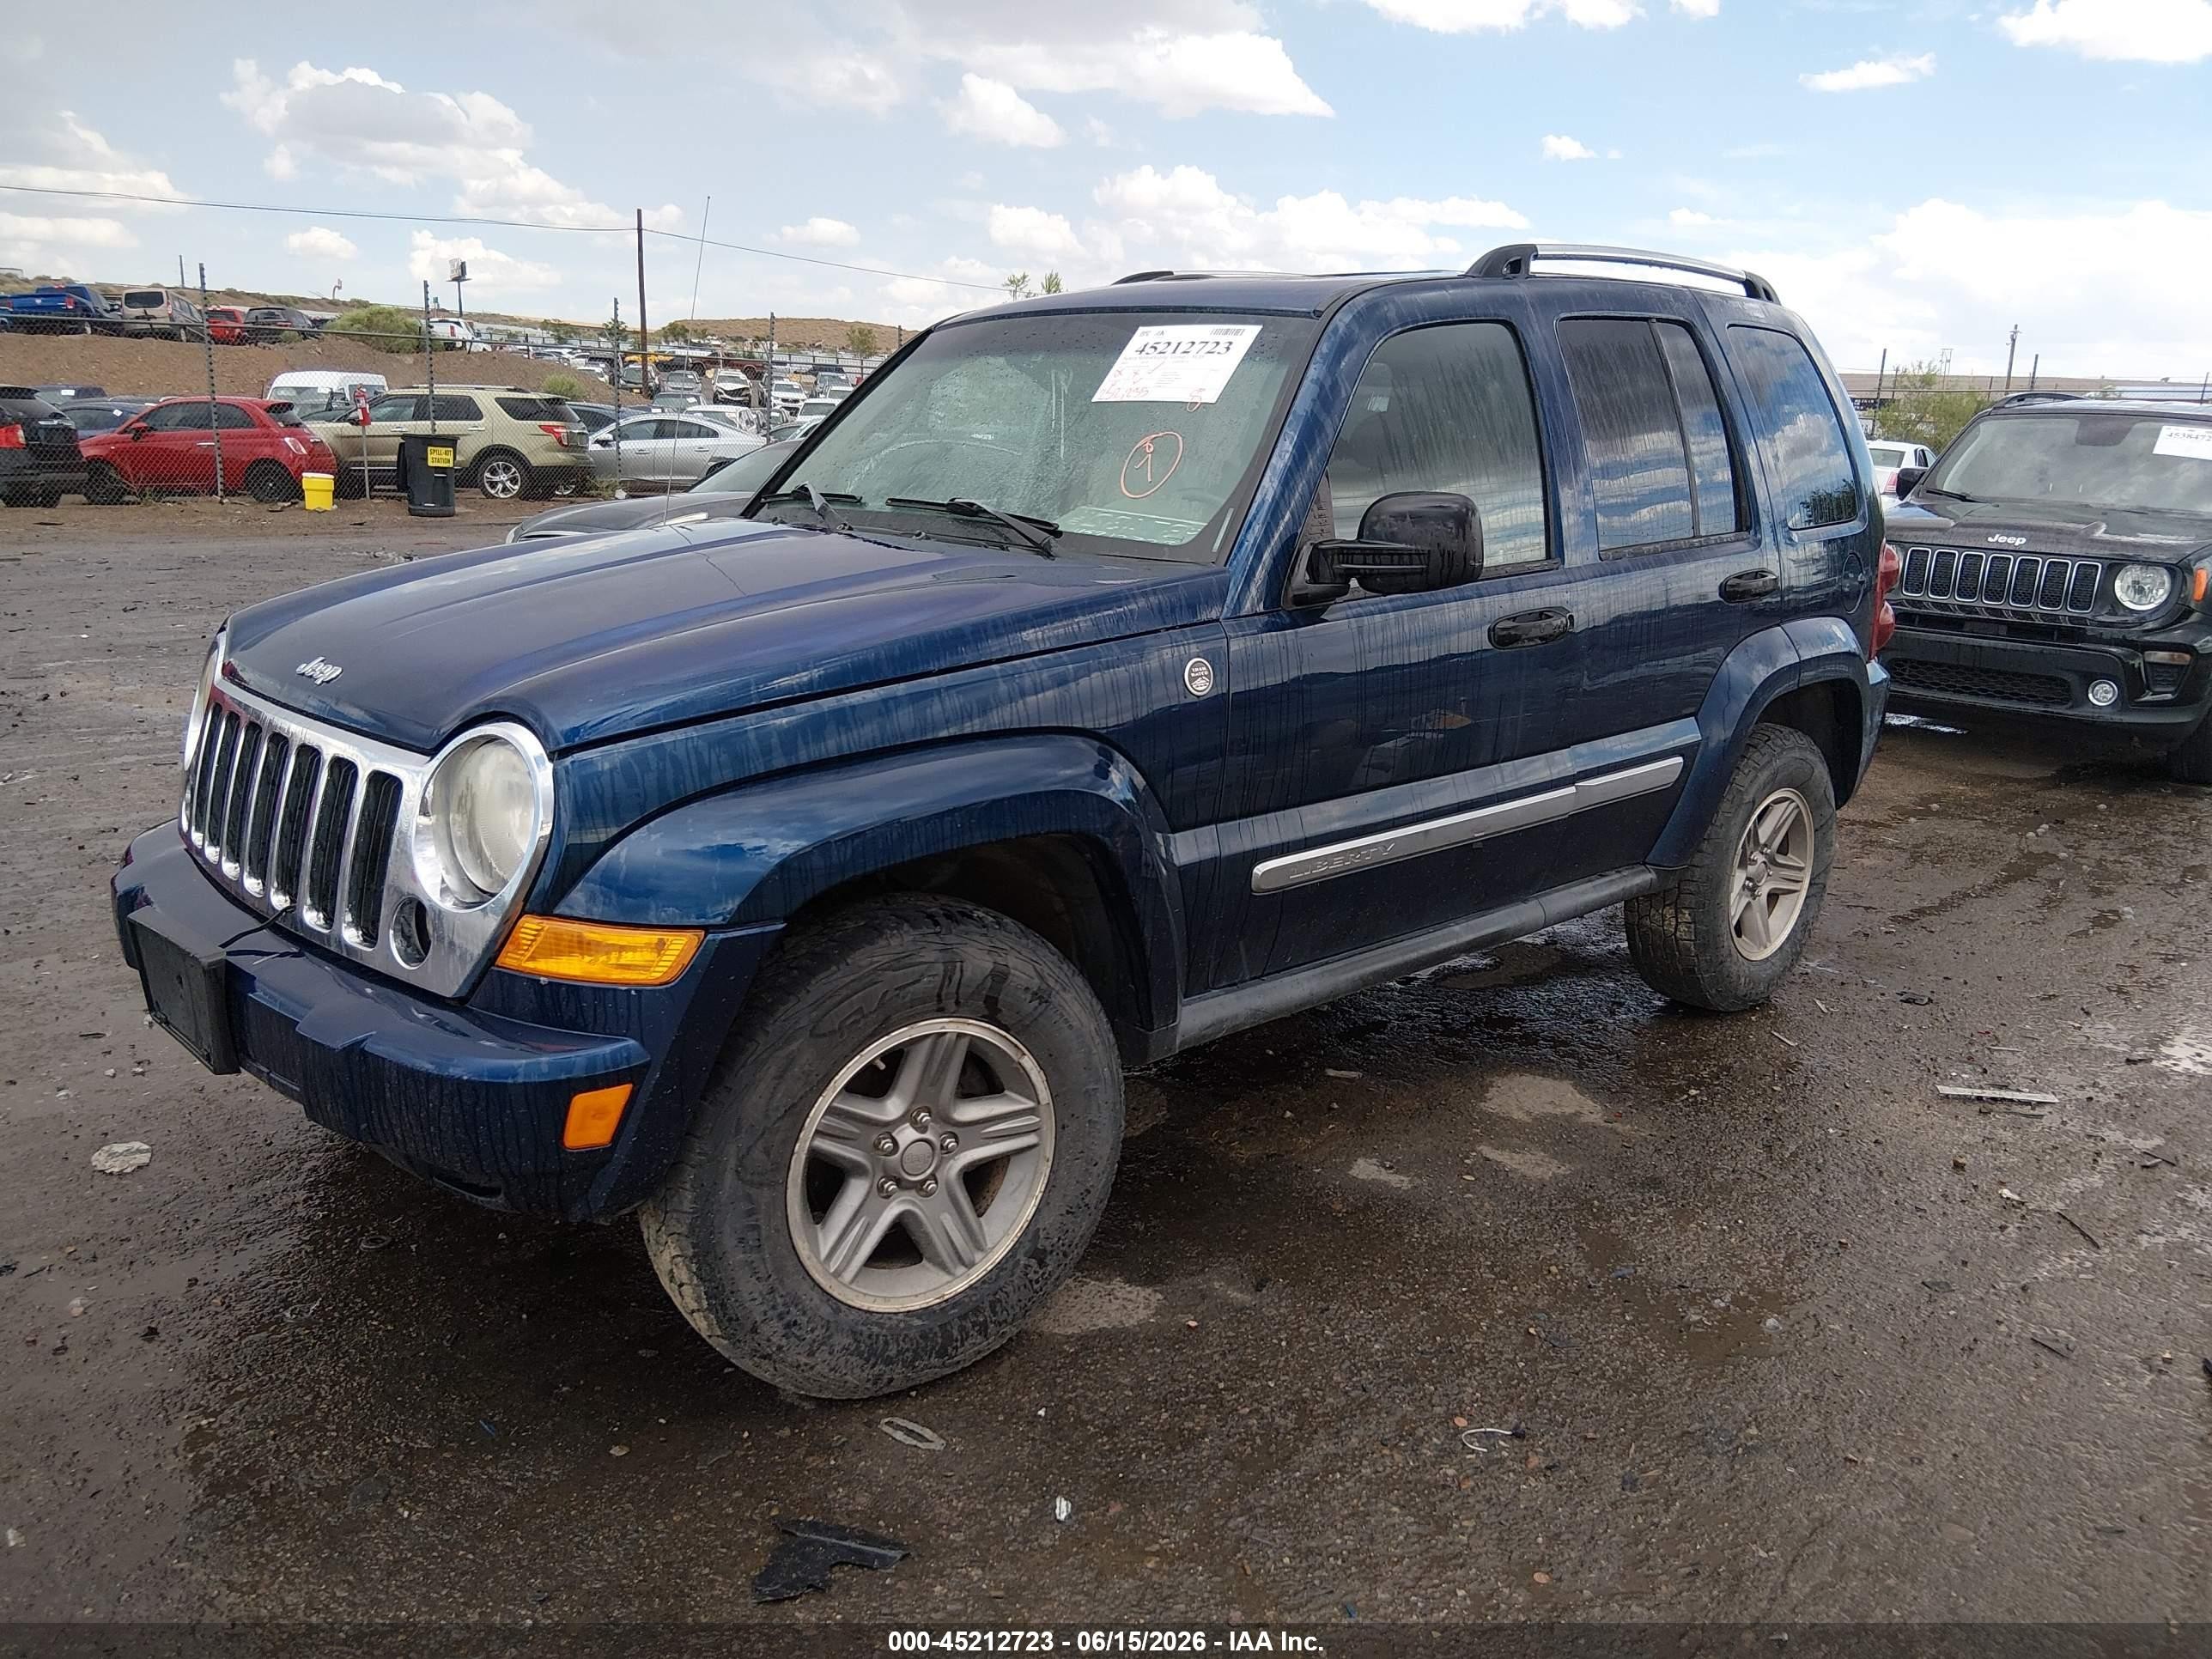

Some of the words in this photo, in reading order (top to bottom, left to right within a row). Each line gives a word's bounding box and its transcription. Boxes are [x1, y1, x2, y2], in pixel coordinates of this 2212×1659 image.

[1135, 340, 1234, 356] 45212723
[1987, 533, 2027, 546] Jeep
[295, 656, 343, 685] Jeep
[1288, 842, 1396, 880] LIBERTY
